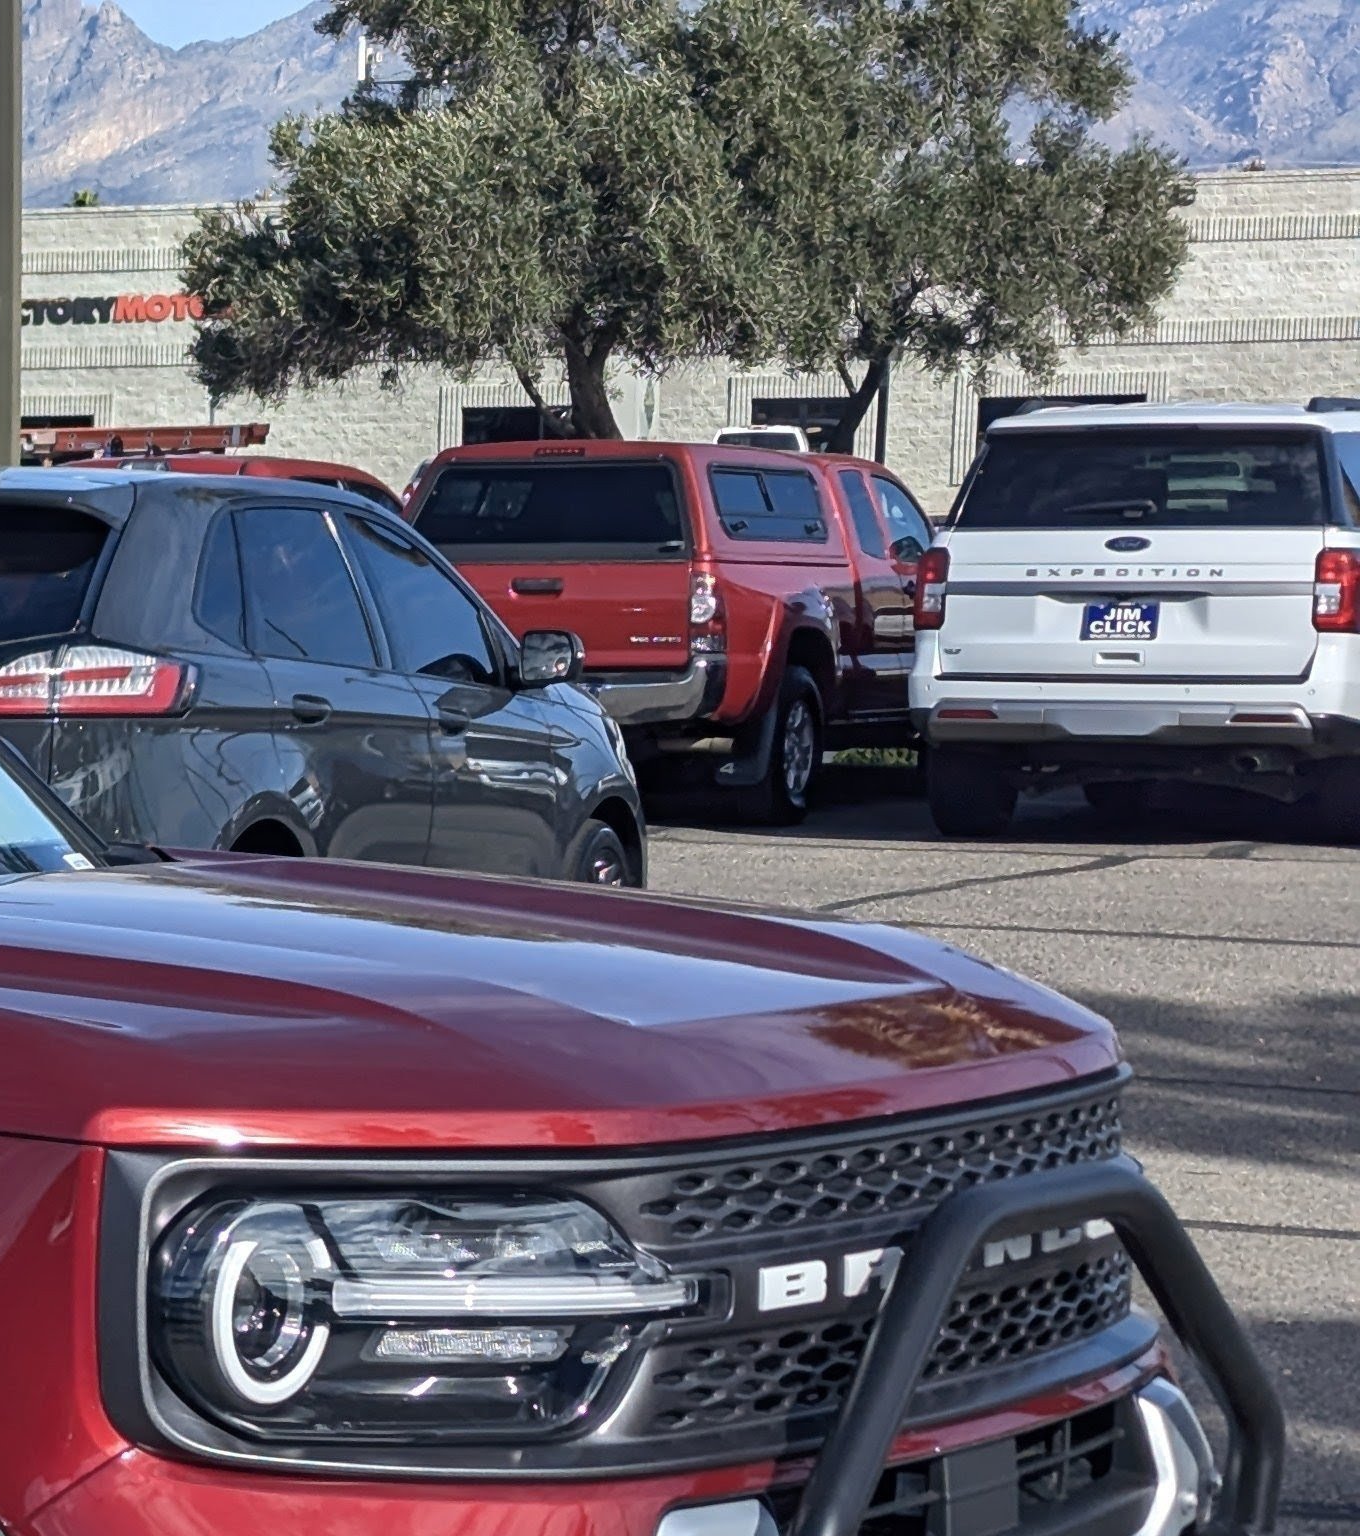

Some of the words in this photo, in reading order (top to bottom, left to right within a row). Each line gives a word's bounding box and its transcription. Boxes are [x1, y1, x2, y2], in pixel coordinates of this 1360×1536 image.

[1026, 567, 1224, 577] EXPEDITION
[1104, 608, 1141, 621] JIM
[1089, 620, 1152, 633] CLICK
